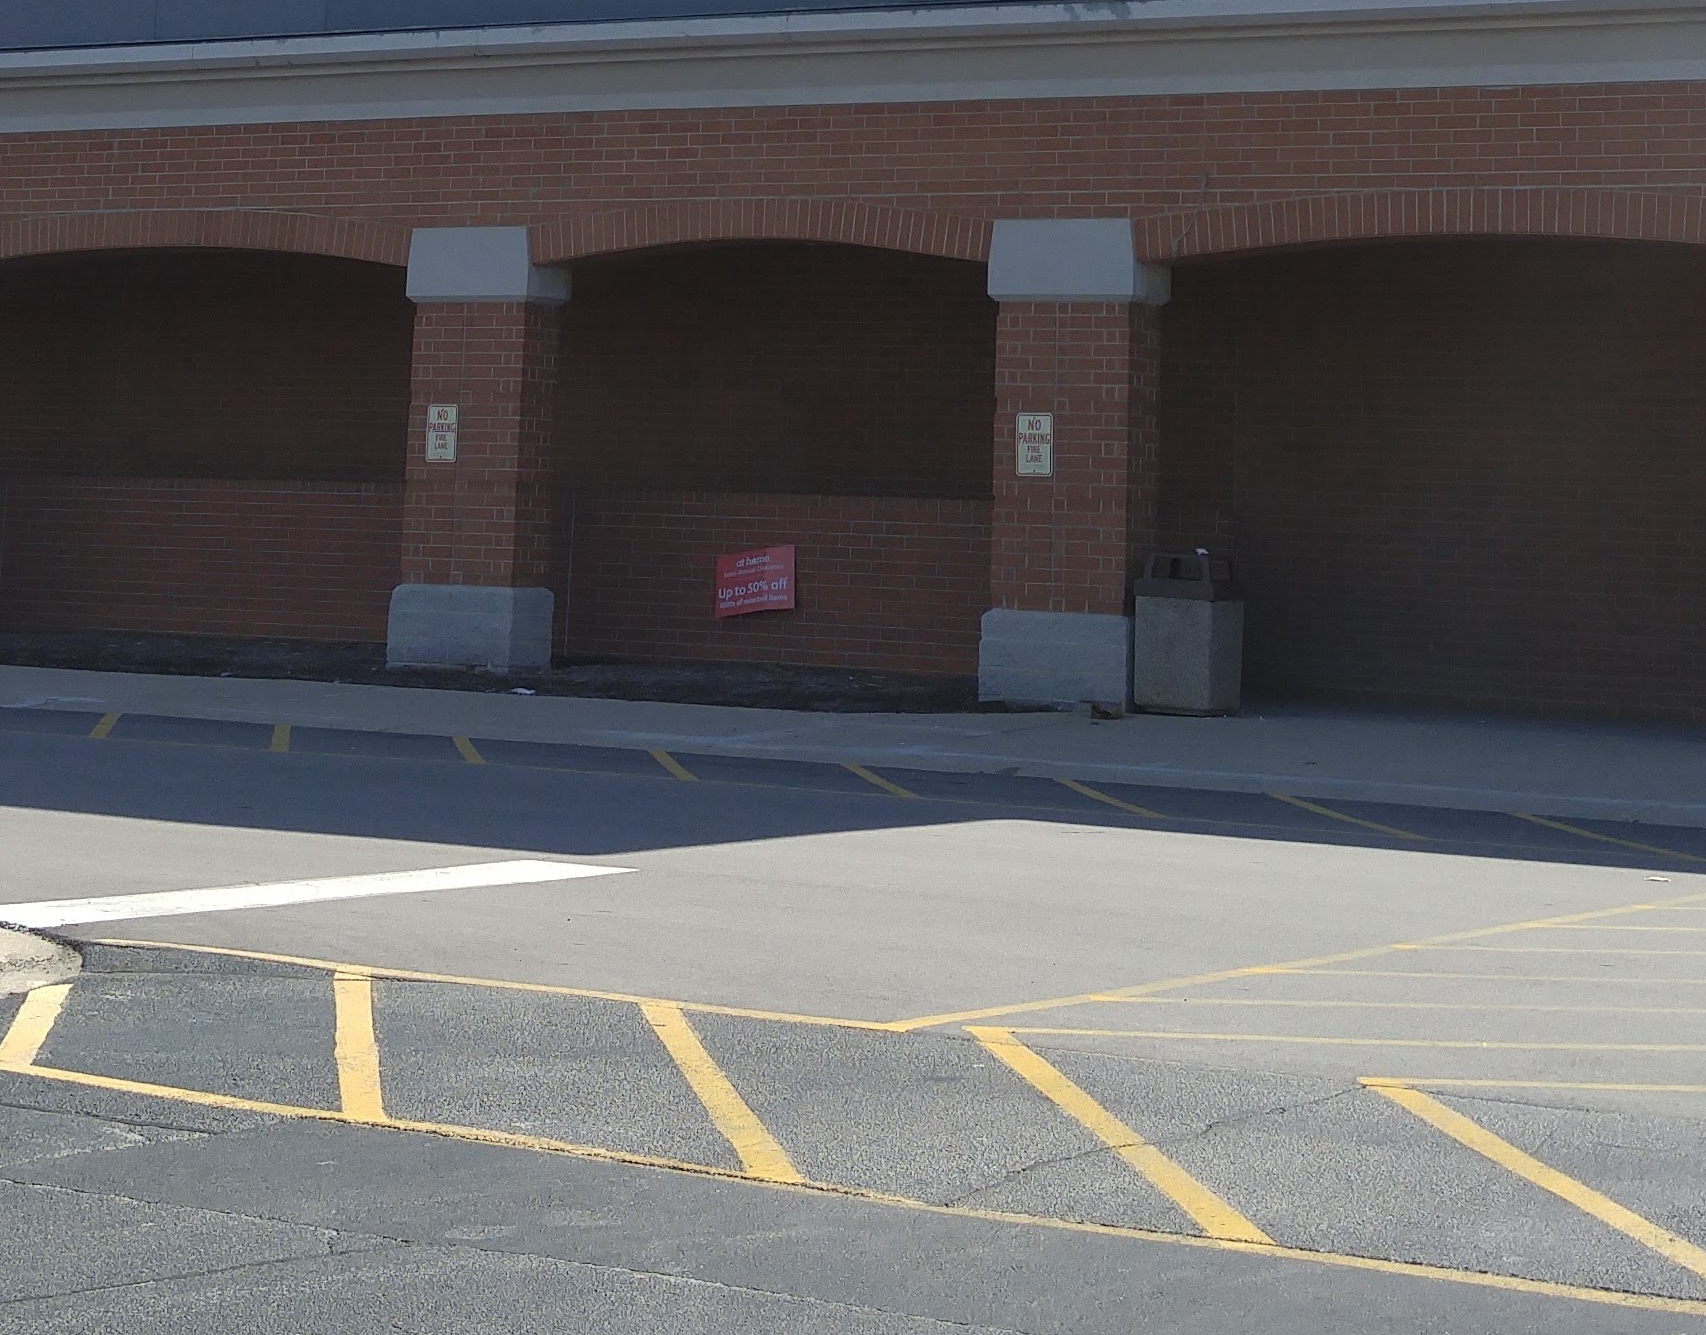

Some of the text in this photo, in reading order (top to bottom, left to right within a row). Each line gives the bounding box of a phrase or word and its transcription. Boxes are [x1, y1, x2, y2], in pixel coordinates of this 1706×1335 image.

[437, 409, 449, 421] NO
[429, 422, 456, 432] PARKING
[1027, 419, 1042, 431] NO
[1018, 432, 1051, 444] PARKING
[1025, 454, 1043, 463] LANE
[718, 577, 788, 600] Up to 50% off
